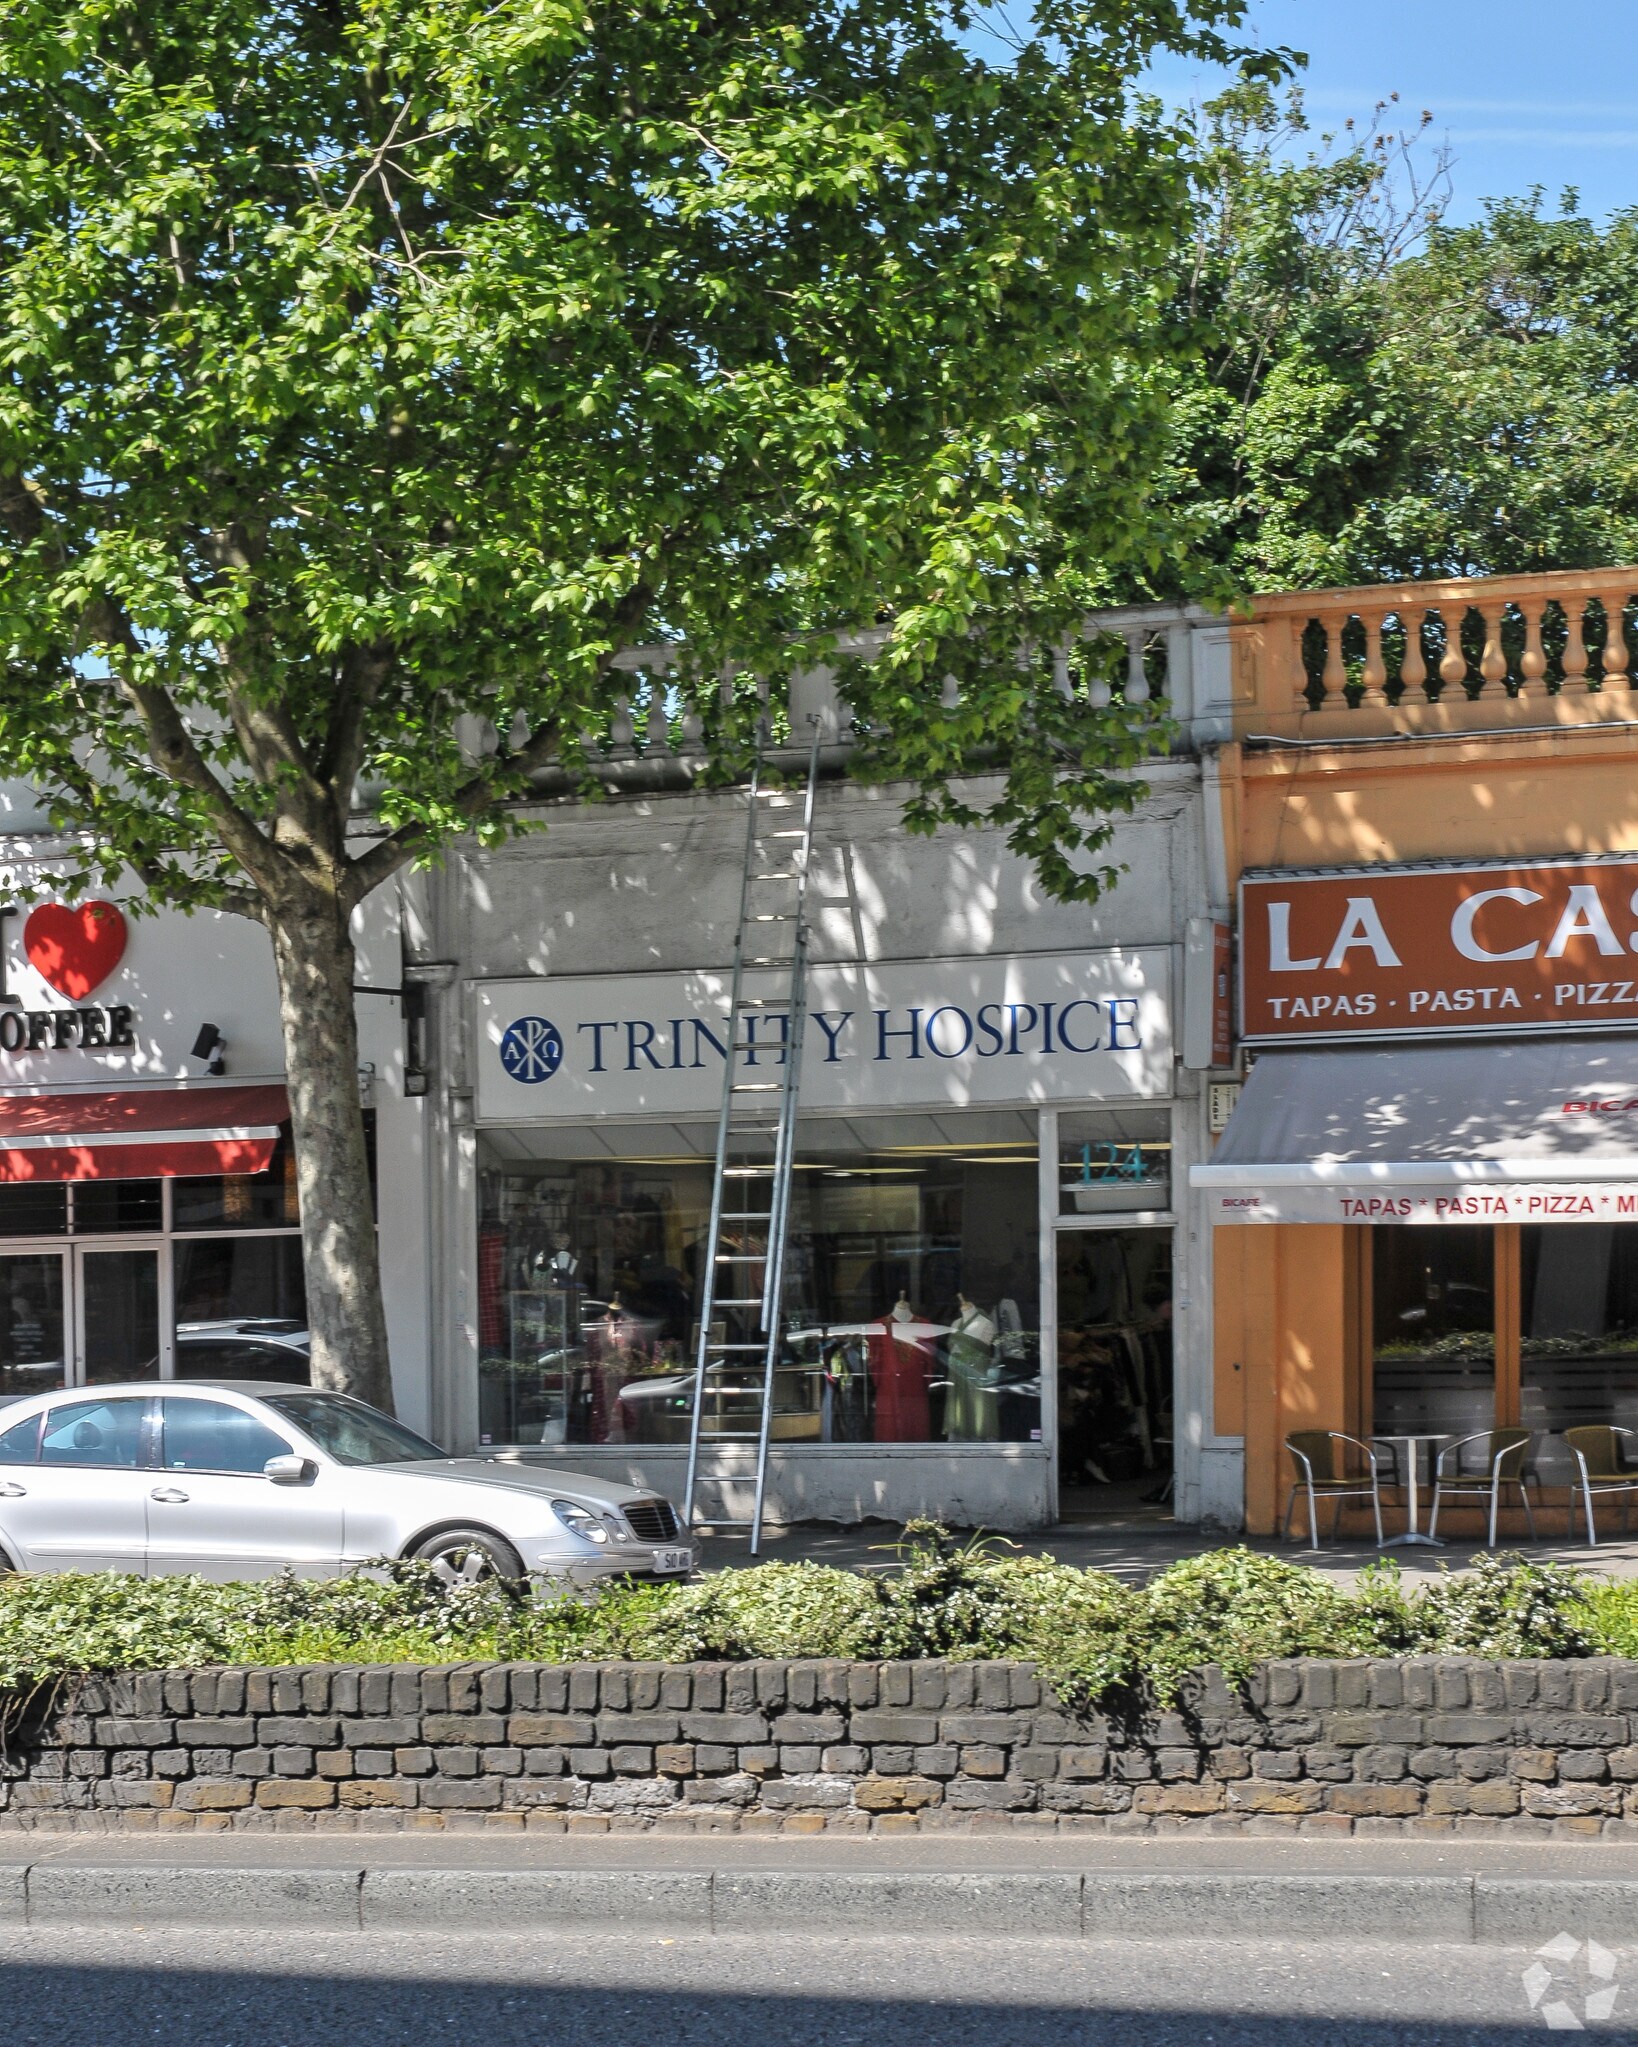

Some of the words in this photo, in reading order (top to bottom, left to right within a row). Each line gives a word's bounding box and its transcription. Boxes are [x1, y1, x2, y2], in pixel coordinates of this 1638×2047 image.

[1266, 896, 1404, 972] LA
[1450, 884, 1638, 962] CA
[1266, 993, 1378, 1019] TAPAS
[1408, 987, 1523, 1013] PASTA
[1554, 981, 1638, 1006] PIZZ
[576, 1011, 856, 1072] TRINITY
[871, 998, 1143, 1061] HOSPICE
[1079, 1140, 1149, 1185] 124
[1340, 1197, 1412, 1217] TAPAS
[1434, 1196, 1509, 1215] PASTA
[1528, 1195, 1595, 1214] PIZZA
